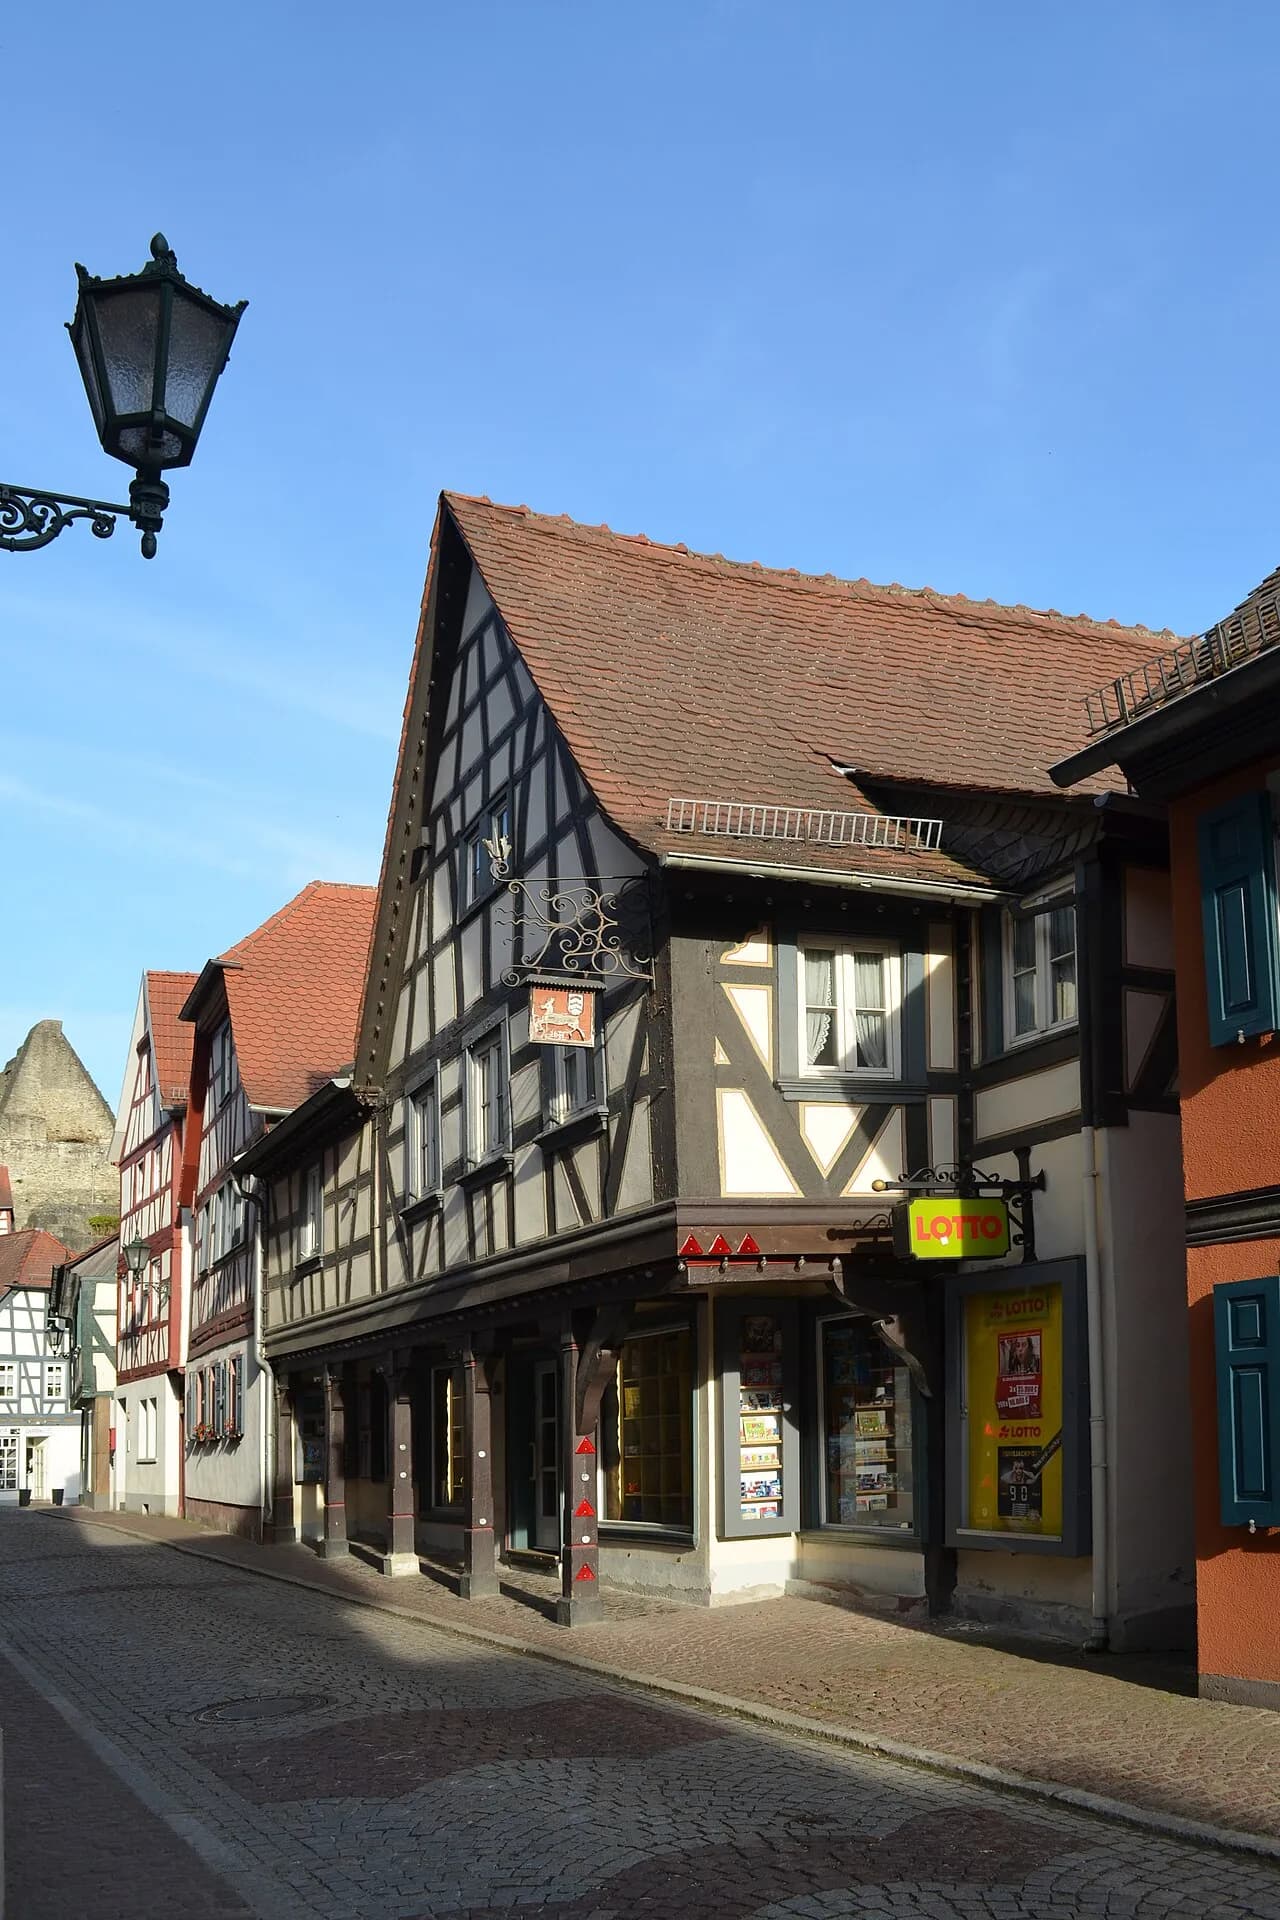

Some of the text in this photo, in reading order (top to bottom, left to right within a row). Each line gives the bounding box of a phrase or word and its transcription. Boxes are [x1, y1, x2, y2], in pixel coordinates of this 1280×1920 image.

[916, 1215, 1003, 1240] LOTTO
[1006, 1298, 1044, 1315] LOTTO
[1011, 1426, 1041, 1438] LOTTO
